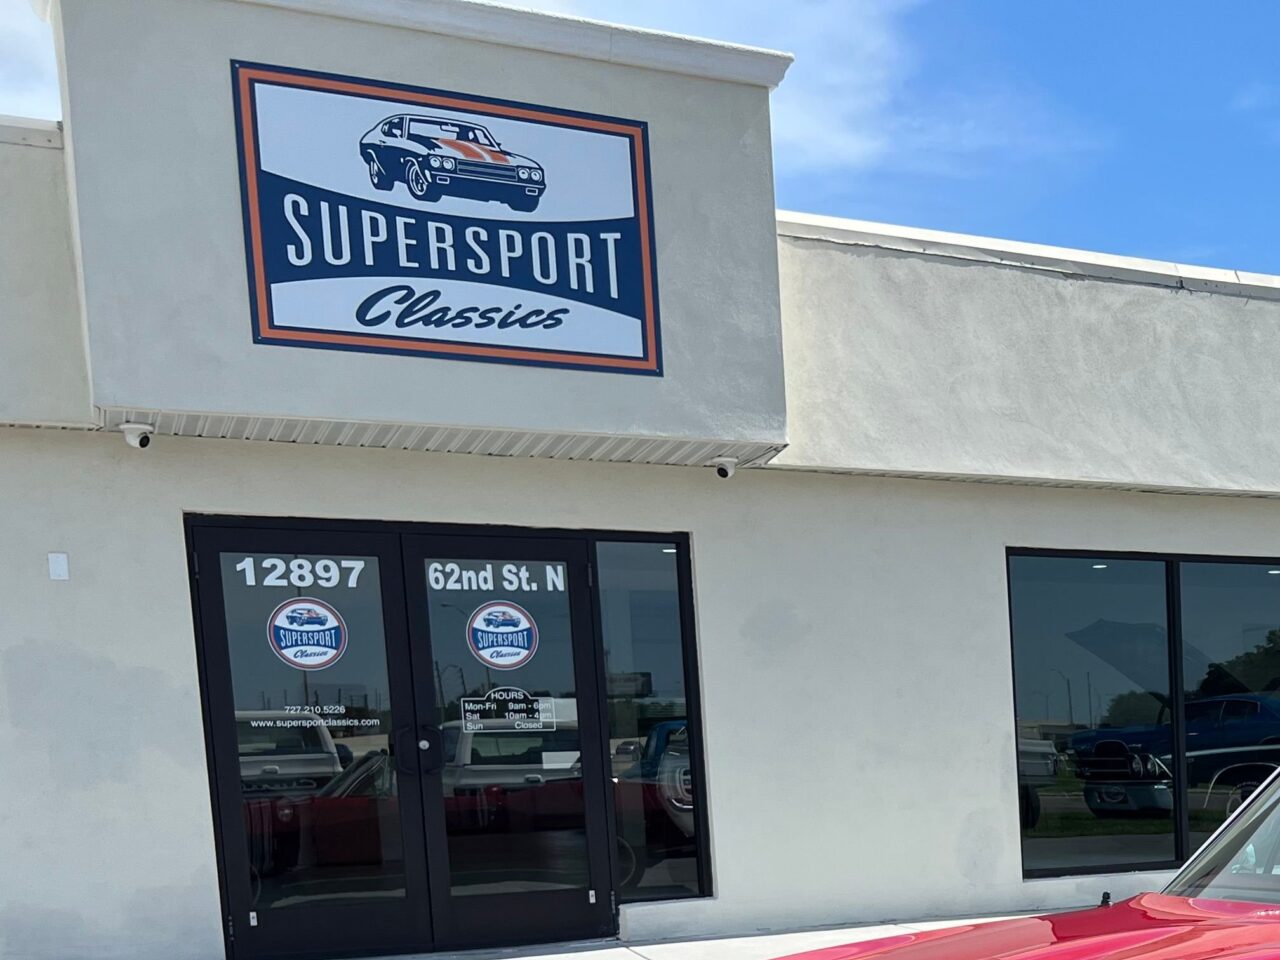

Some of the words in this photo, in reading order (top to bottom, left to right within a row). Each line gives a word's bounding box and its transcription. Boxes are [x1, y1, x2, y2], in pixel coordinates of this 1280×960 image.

[283, 193, 622, 300] SUPERSPORT
[355, 285, 570, 331] Classics
[236, 557, 365, 588] 12897
[428, 562, 494, 591] 62nd
[502, 564, 538, 591] St.
[545, 565, 565, 591] N
[279, 629, 336, 648] SUPERSPORT
[477, 630, 529, 648] SUPERSPORT
[293, 649, 329, 659] Classics
[490, 691, 524, 700] HOURS
[464, 702, 497, 711] Mon-Fri
[508, 702, 526, 710] 9am
[465, 712, 480, 720] Sat
[504, 712, 527, 720] 10am
[250, 718, 380, 729] www.supersportclassics.com
[466, 721, 484, 730] Sun
[514, 721, 543, 730] Closed
